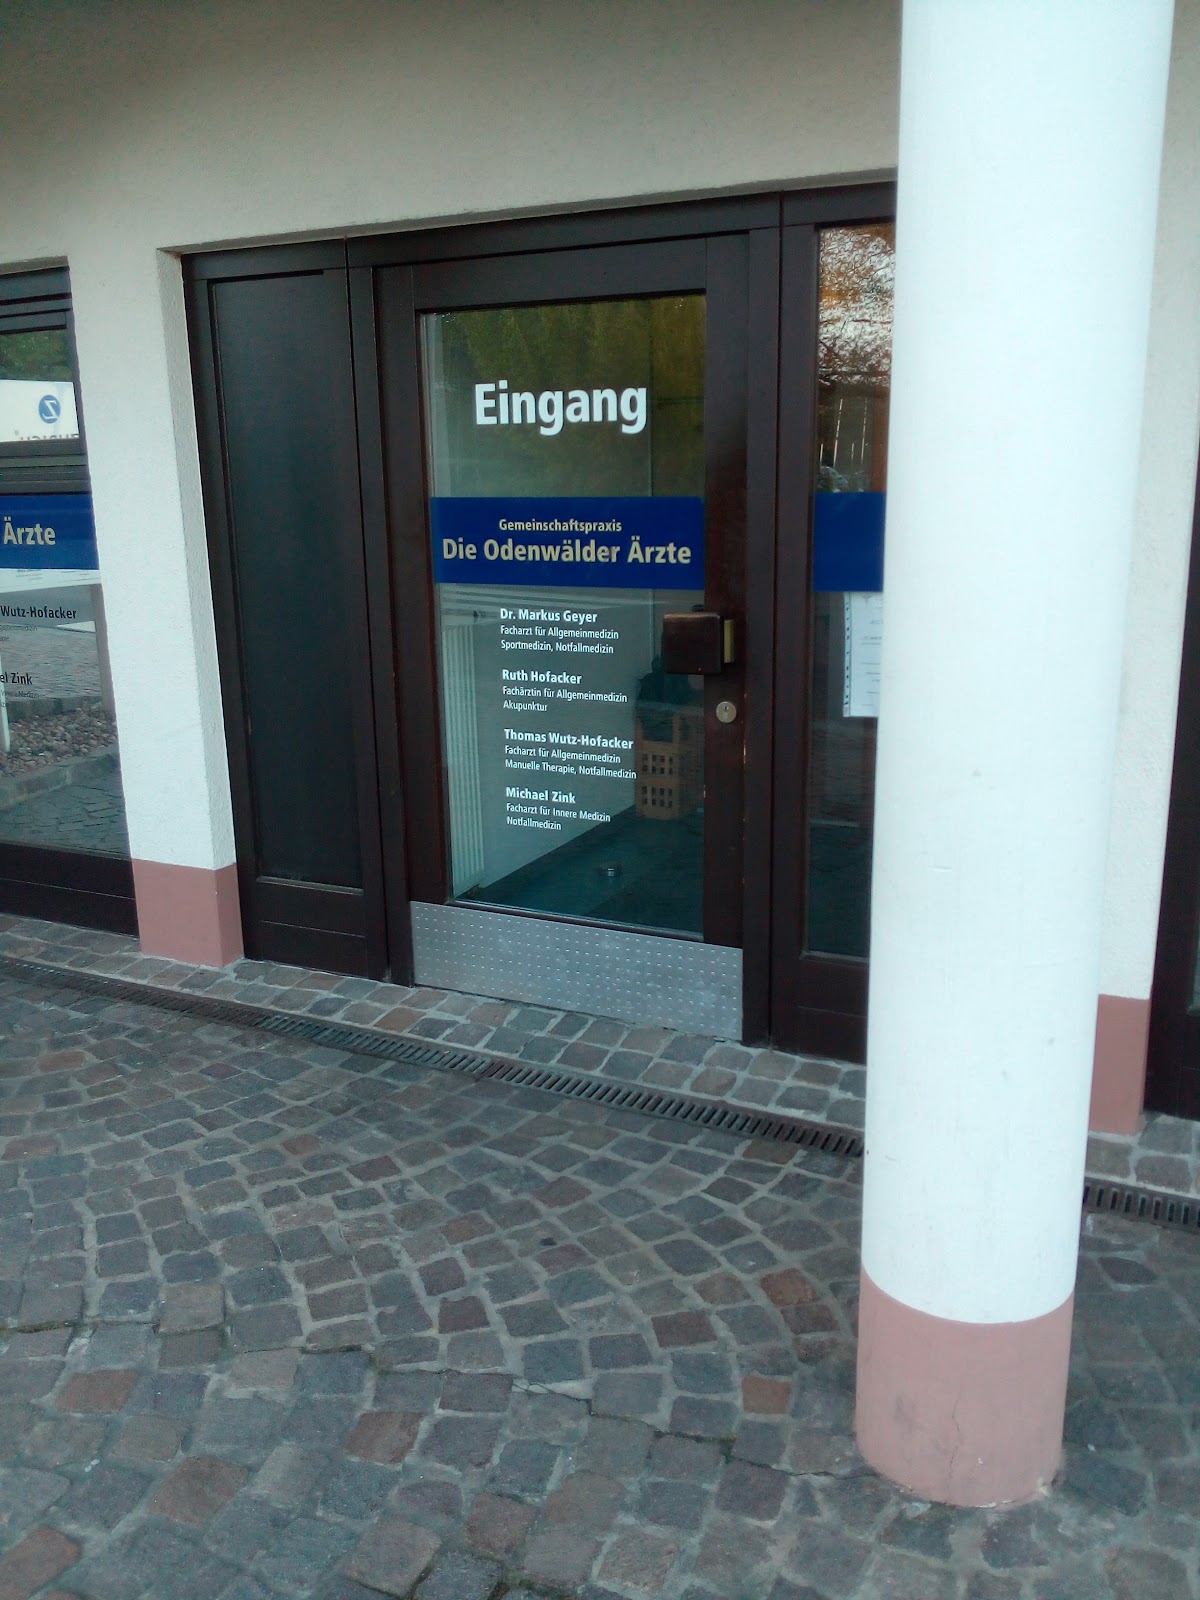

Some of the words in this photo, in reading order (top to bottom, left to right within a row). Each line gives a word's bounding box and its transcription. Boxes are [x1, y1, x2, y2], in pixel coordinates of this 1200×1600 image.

[475, 380, 647, 436] Eingang
[3, 516, 56, 545] Ärzte
[499, 518, 622, 534] Gemeinschaftspraxis
[442, 537, 477, 560] Die
[483, 538, 620, 563] Odenwälder
[627, 536, 692, 564] Ärzte
[0, 605, 77, 619] Wutz-Hofacker
[500, 608, 516, 620] Dr.
[518, 609, 560, 621] Markus
[563, 610, 598, 625] Geyer
[500, 625, 532, 636] Facharzt
[535, 626, 546, 636] für
[548, 627, 619, 639] Allgemeinmedizin
[501, 640, 553, 652] Sportmedizin,
[556, 642, 614, 654] Notfallmedizin
[10, 672, 32, 684] Zink
[502, 669, 528, 681] Ruth
[531, 670, 582, 684] Hofacker
[502, 686, 541, 697] Fachärztin
[544, 688, 555, 698] für
[556, 689, 628, 702] Allgemeinmedizin
[503, 700, 548, 712] Akupunktur
[504, 728, 546, 742] Thomas
[549, 732, 634, 749] Wutz-Hofacker
[505, 745, 536, 756] Facharzt
[538, 748, 550, 757] für
[551, 749, 621, 764] Allgemeinmedizin
[505, 760, 540, 770] Manuelle
[542, 762, 577, 774] Therapie,
[579, 765, 637, 779] Notfallmedizin
[506, 786, 549, 801] Michael
[552, 791, 576, 804] Zink
[506, 802, 538, 814] Facharzt
[540, 805, 550, 815] für
[553, 808, 577, 818] Innere
[580, 810, 611, 822] Medizin
[506, 816, 562, 830] Notfallmedizin
